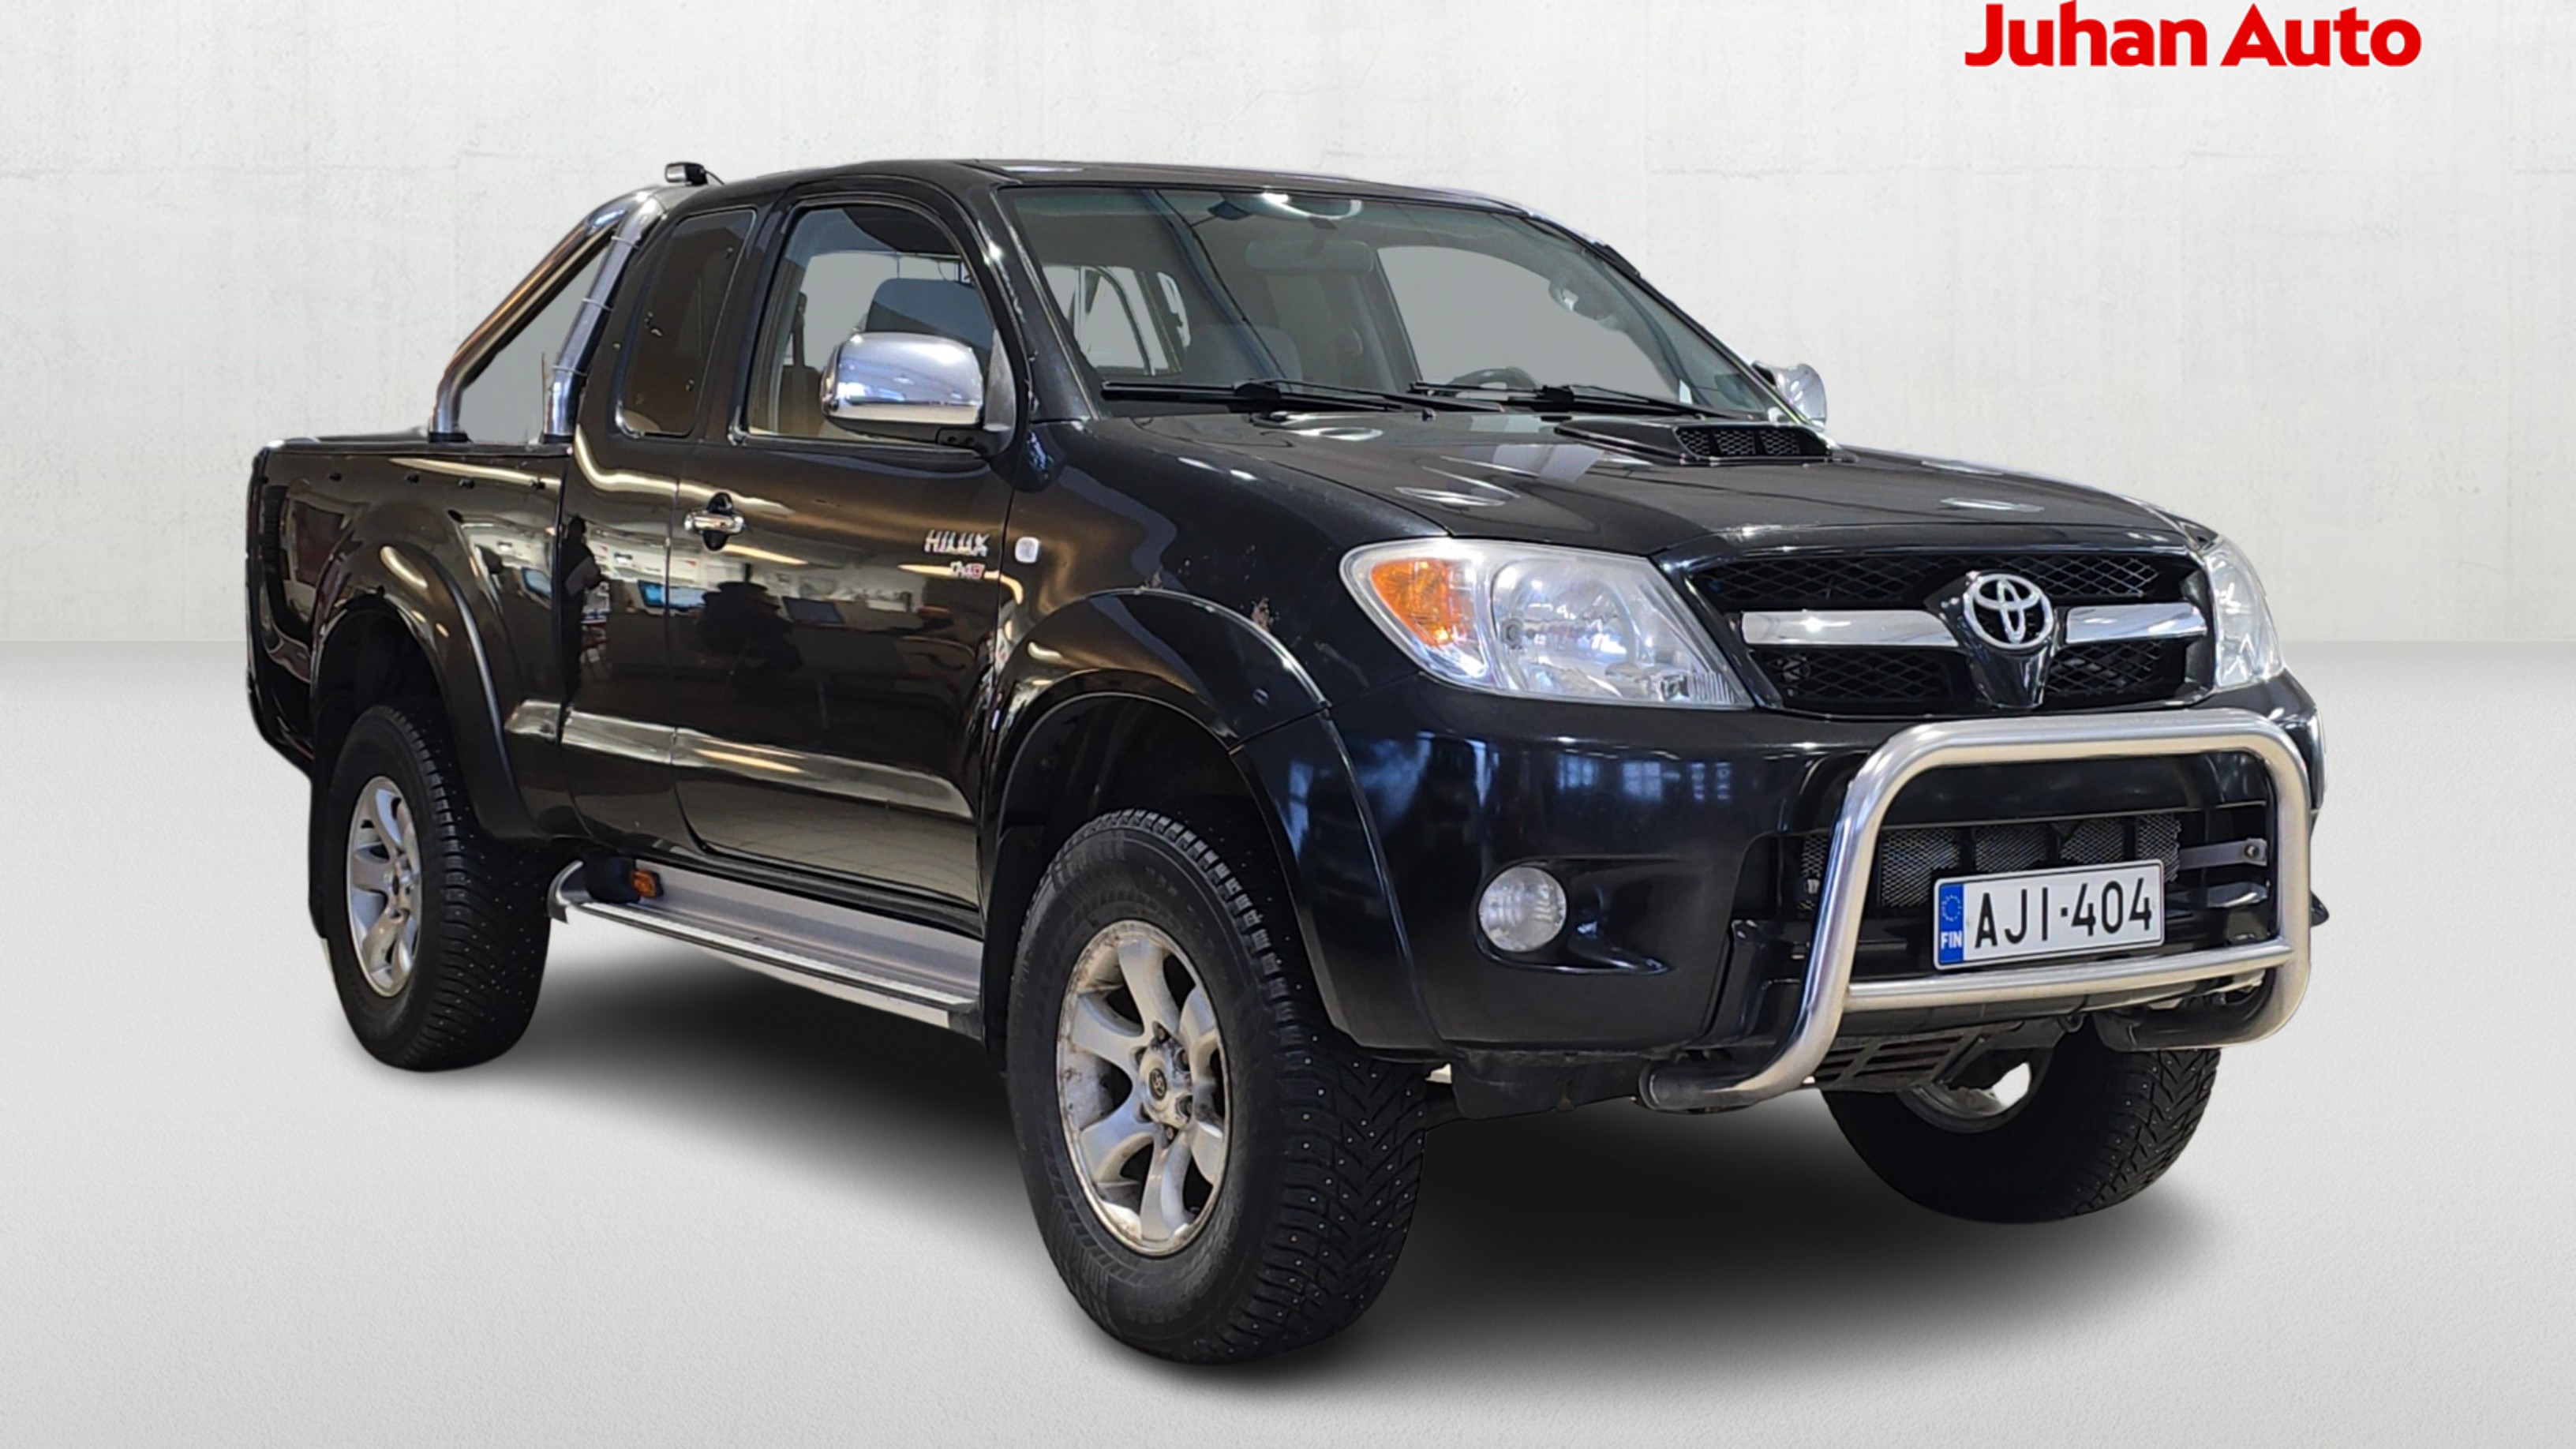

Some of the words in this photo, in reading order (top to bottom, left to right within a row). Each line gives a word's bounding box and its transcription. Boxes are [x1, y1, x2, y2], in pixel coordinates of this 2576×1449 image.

[923, 530, 990, 557] HILUX
[1975, 878, 2152, 949] AJI-404
[1940, 930, 1963, 950] FIN
